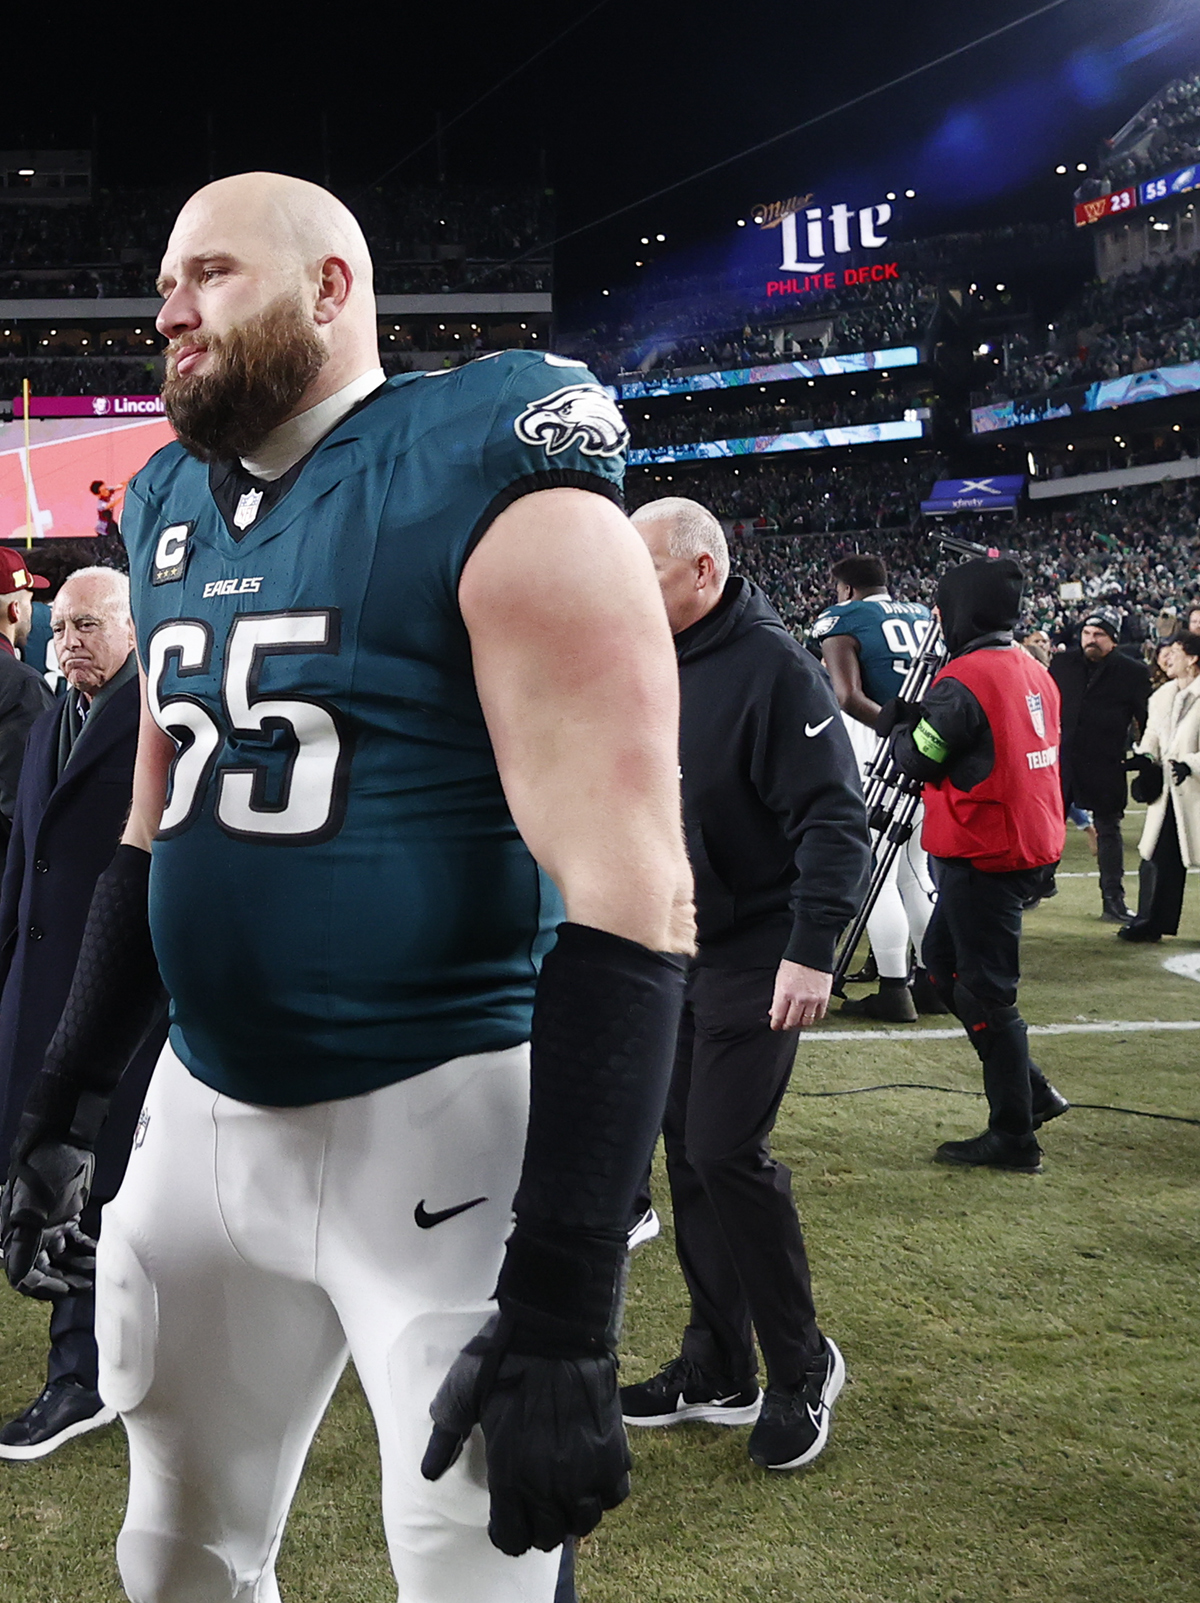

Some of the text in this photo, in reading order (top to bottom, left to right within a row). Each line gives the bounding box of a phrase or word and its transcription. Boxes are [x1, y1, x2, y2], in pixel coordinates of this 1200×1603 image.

[751, 193, 814, 224] Miller
[1110, 192, 1131, 212] 23
[1146, 179, 1167, 200] 55
[779, 203, 892, 273] Lite
[766, 262, 899, 297] PHLITE DECK
[155, 525, 188, 569] C
[202, 577, 264, 599] EAGLES
[879, 601, 922, 614] DAVIS
[147, 607, 345, 843] 65
